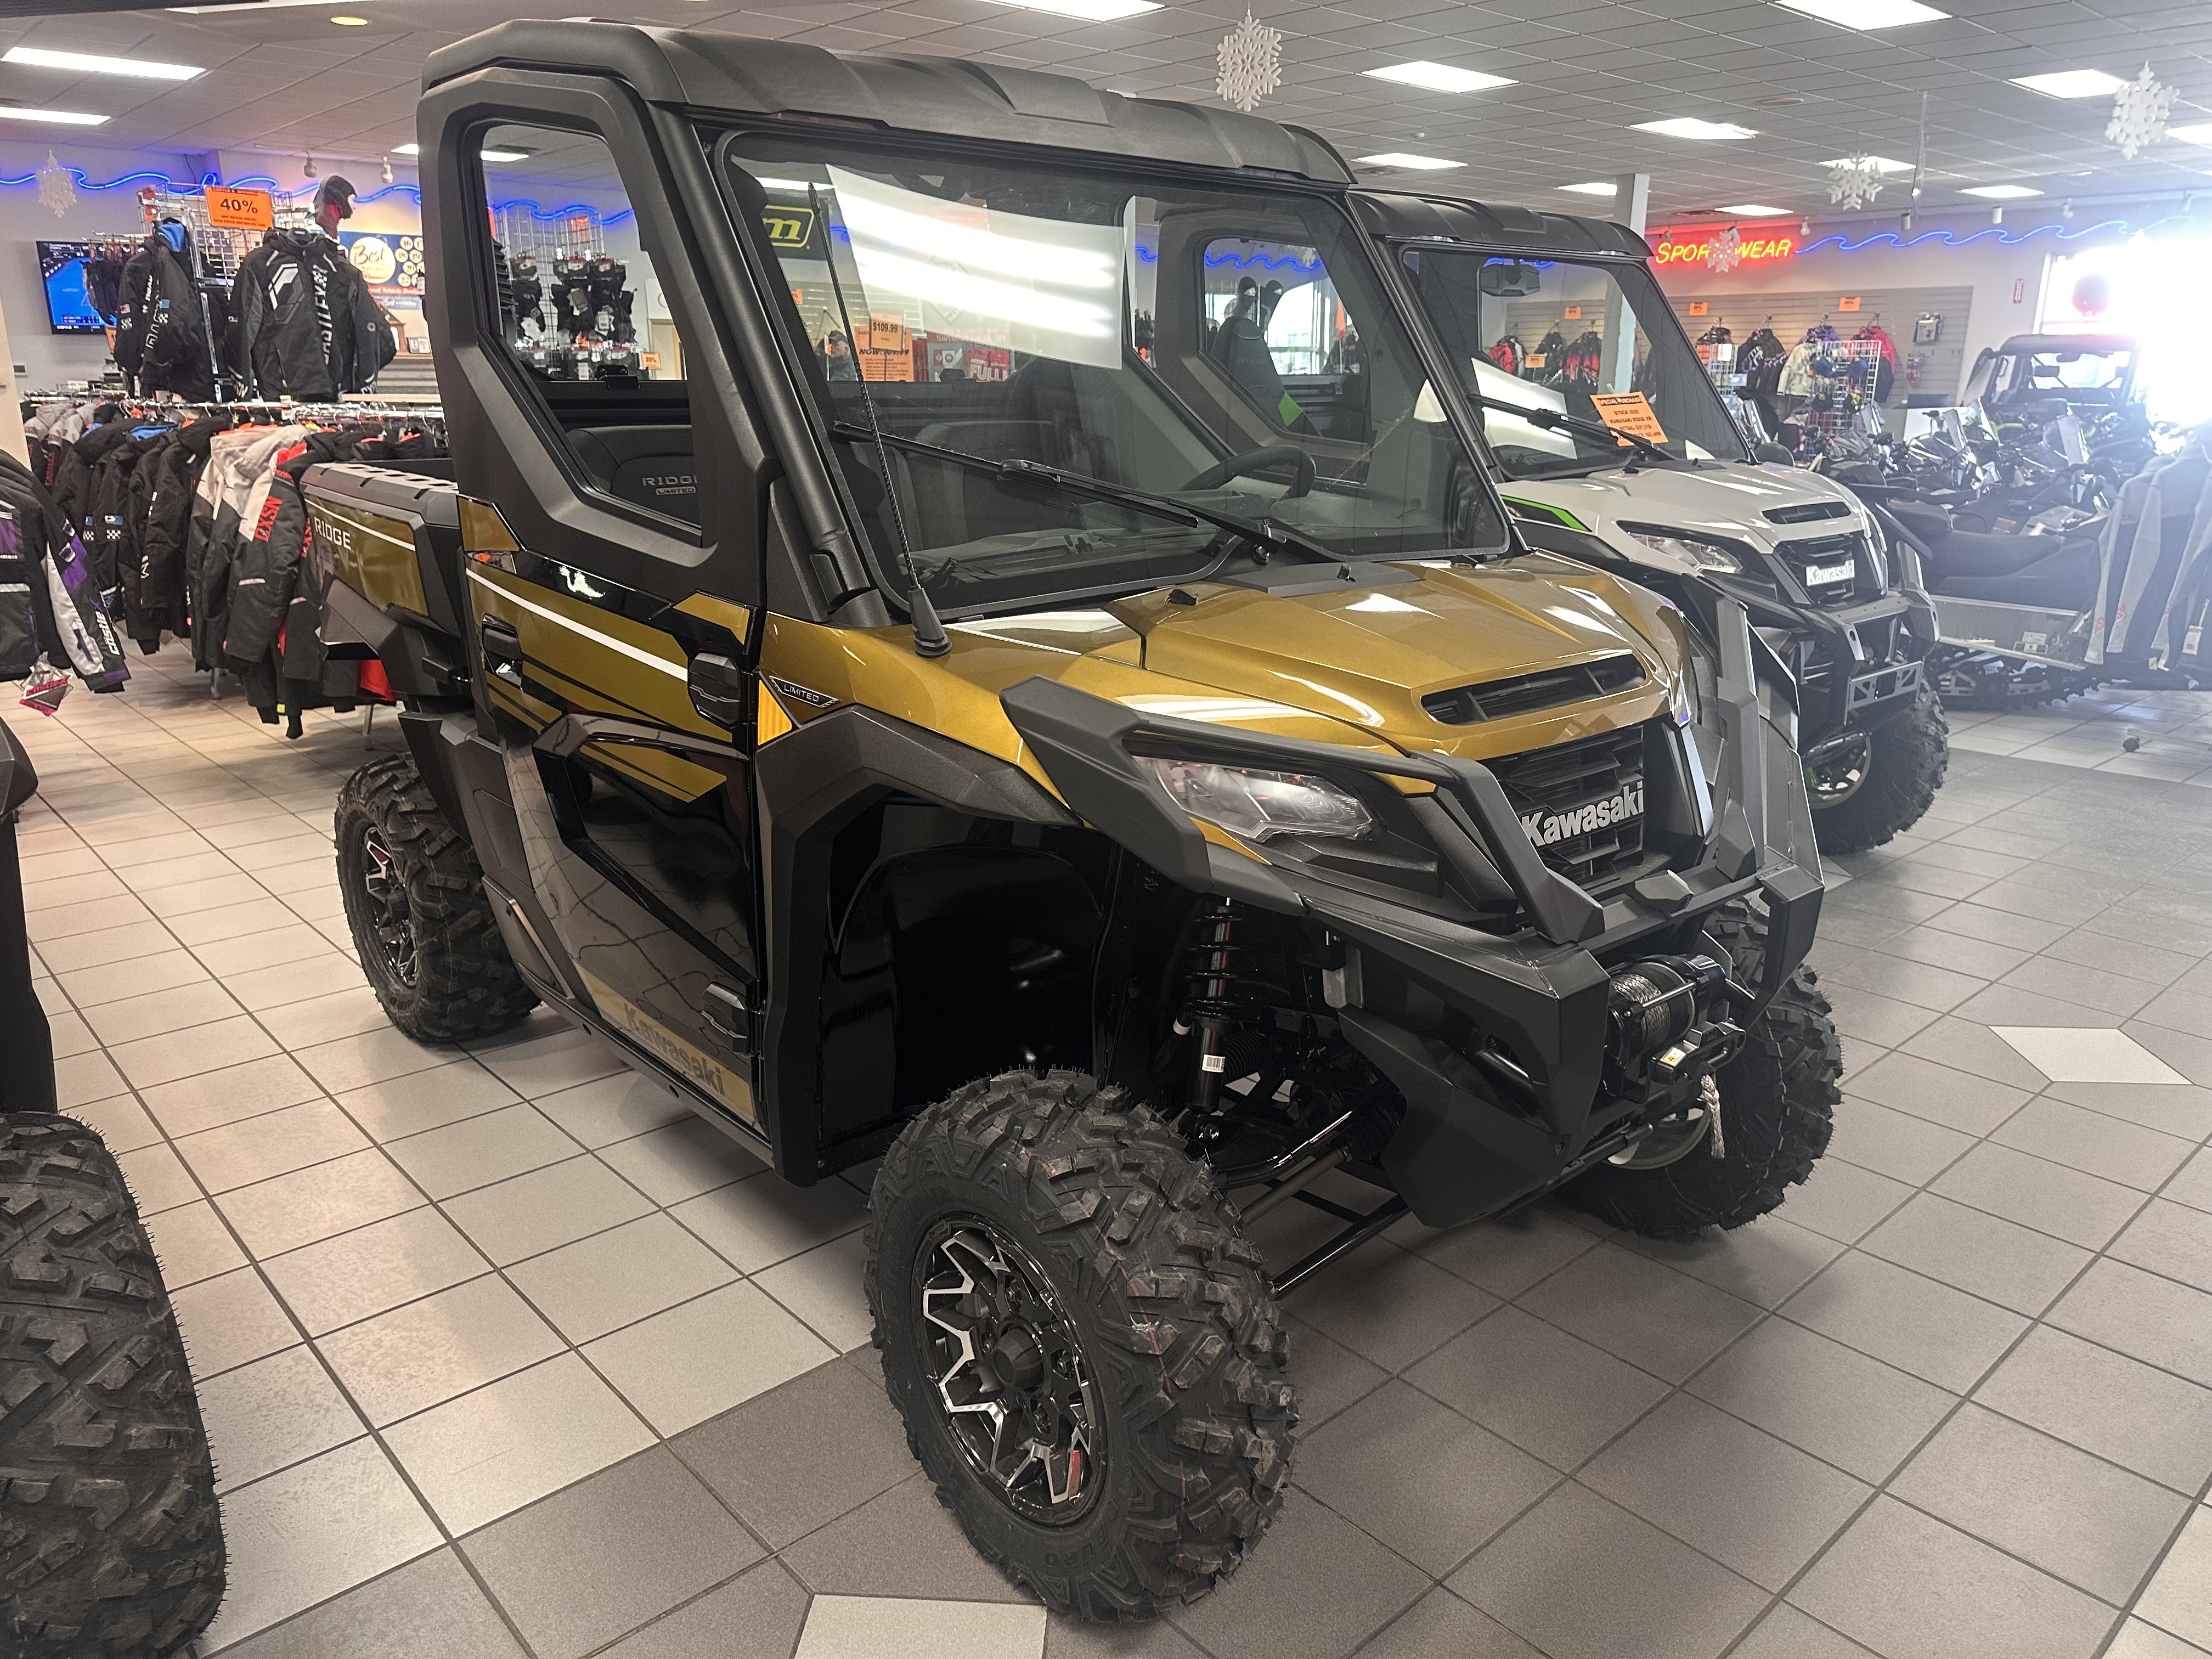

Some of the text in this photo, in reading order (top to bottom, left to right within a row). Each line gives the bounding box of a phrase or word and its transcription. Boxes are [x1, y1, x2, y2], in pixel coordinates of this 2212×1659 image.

[220, 198, 258, 213] 40%
[1656, 239, 1791, 264] SPORWEAR
[873, 323, 898, 333] $109.99
[314, 516, 351, 550] RIDGE
[1807, 560, 1854, 585] Kawasaki
[784, 684, 820, 703] LIMITED
[1521, 781, 1644, 847] Kawasaki
[623, 1002, 725, 1097] Kawasaki
